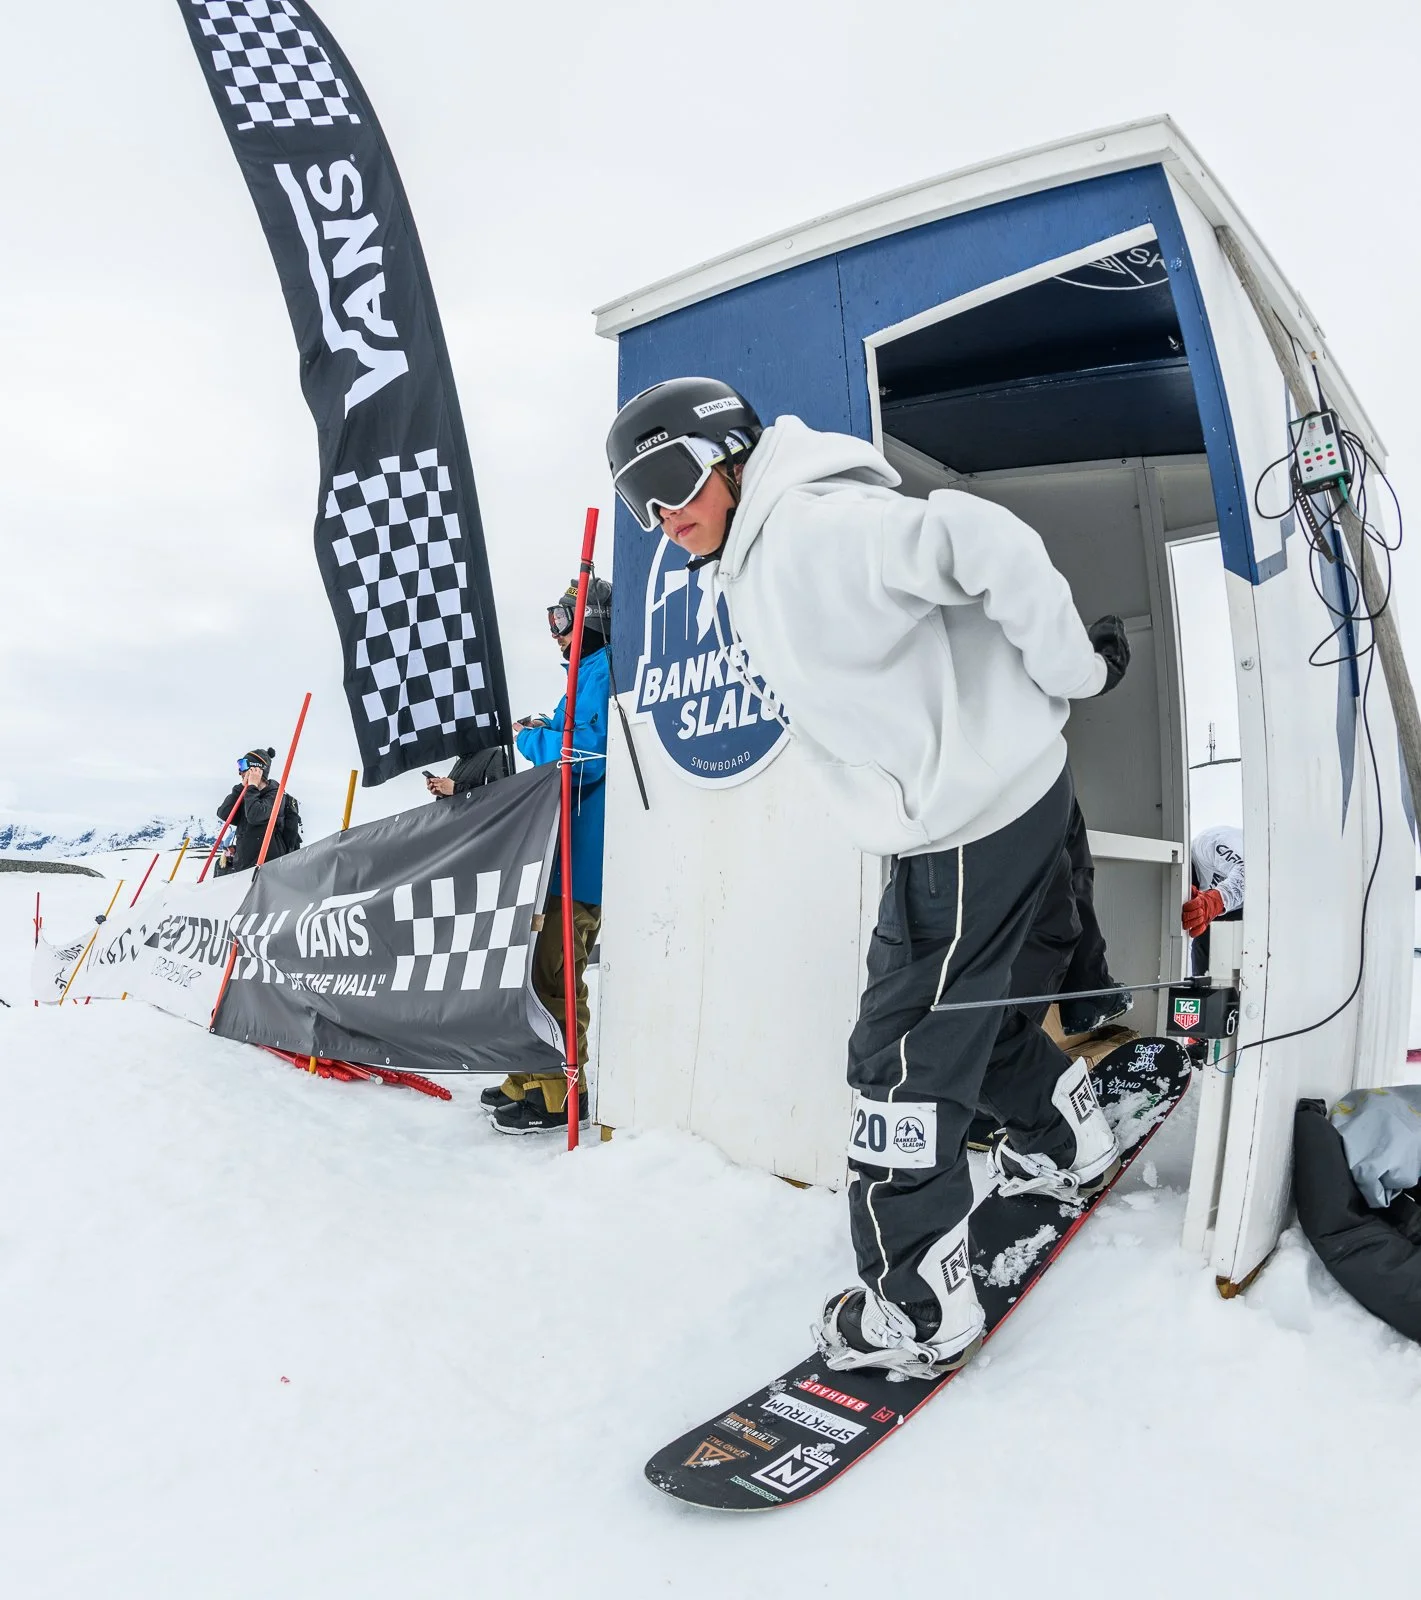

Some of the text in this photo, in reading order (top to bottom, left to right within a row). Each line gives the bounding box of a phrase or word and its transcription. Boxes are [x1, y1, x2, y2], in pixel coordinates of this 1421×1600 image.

[273, 159, 409, 420] VANS
[699, 400, 741, 415] STAND TALL
[636, 431, 669, 454] GIRO
[677, 683, 789, 740] SLALO
[690, 751, 751, 772] SNOWBOARD
[296, 888, 381, 959] VANS
[305, 973, 334, 993] THE
[332, 974, 387, 997] WALL"
[1179, 1001, 1197, 1013] TAG
[1175, 1014, 1200, 1028] HEUER
[1107, 1080, 1141, 1088] STAND
[801, 1380, 865, 1411] BAUHAUS
[707, 1435, 750, 1459] STAND TALL
[802, 1446, 840, 1467] NITRO
